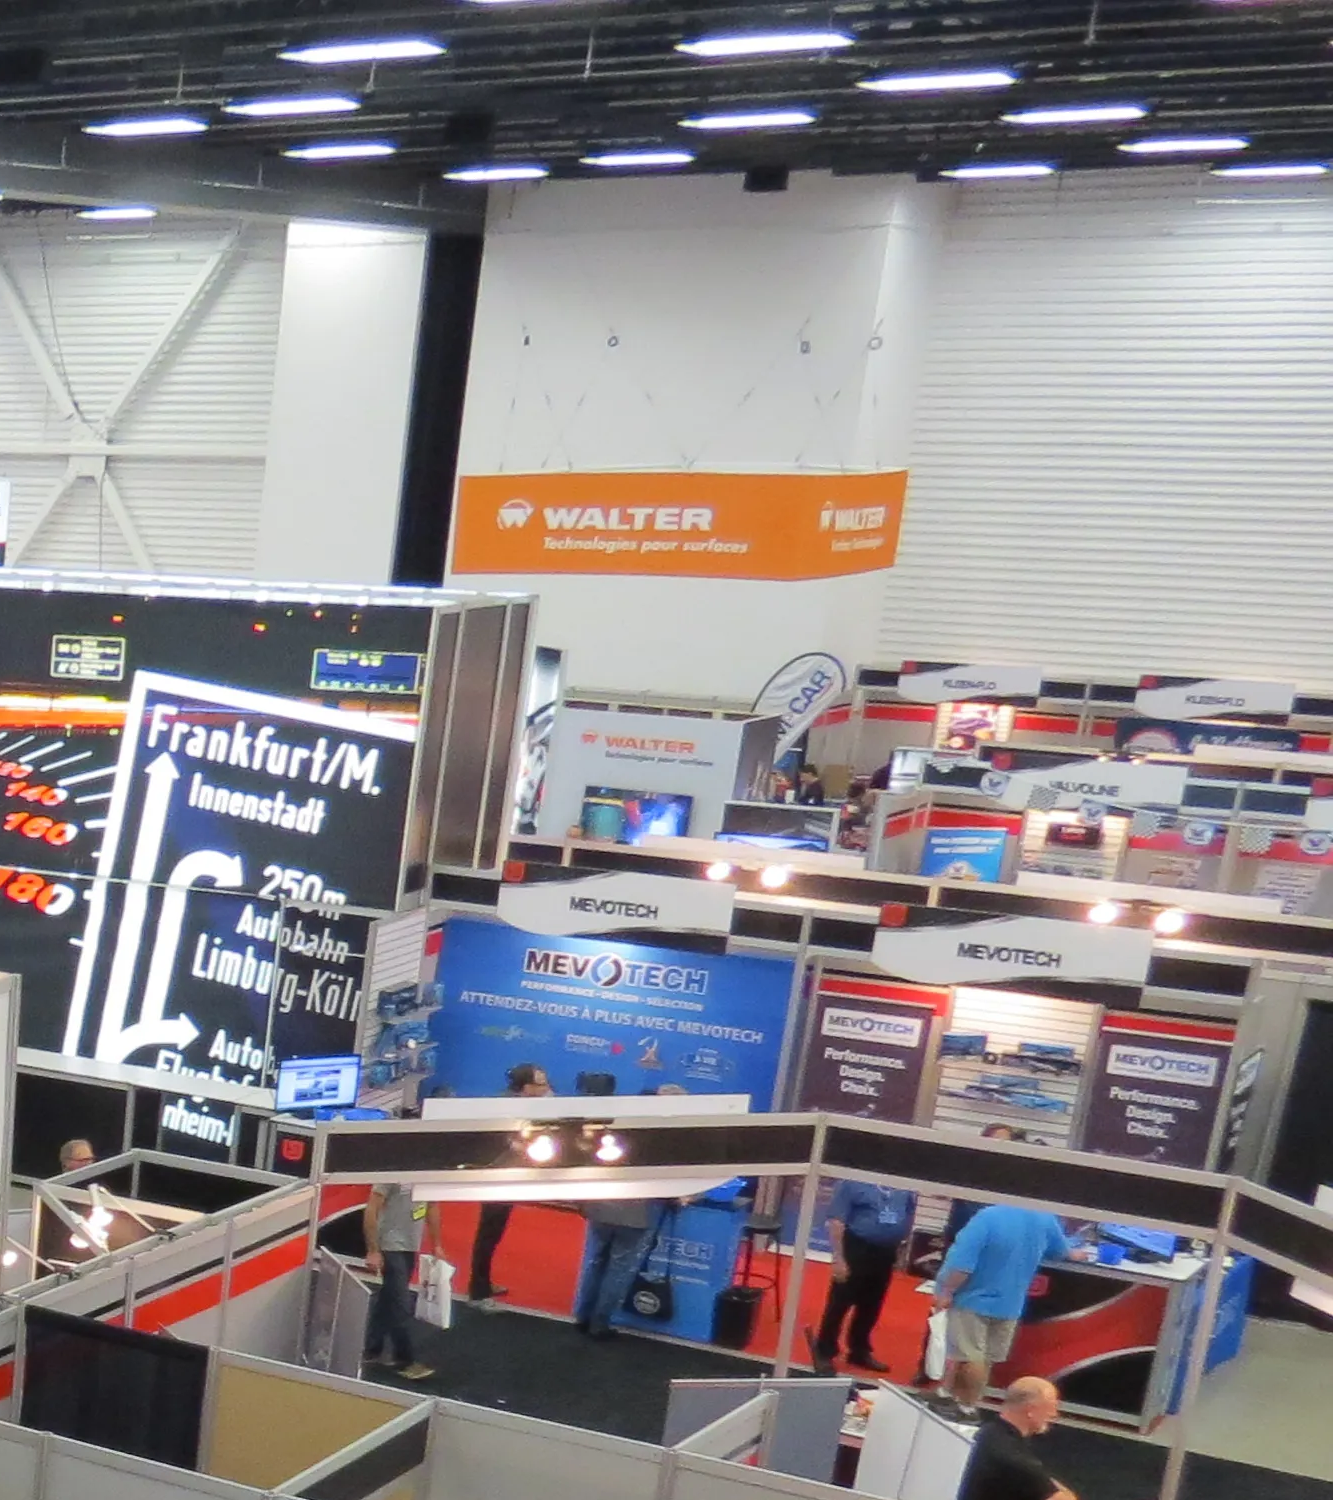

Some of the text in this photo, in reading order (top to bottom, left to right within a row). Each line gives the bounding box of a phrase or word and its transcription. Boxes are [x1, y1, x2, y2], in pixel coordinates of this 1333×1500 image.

[543, 506, 713, 532] WALTER
[834, 504, 886, 530] WALTER
[543, 535, 749, 555] Technologies pour surfaces
[146, 703, 382, 797] Frankfurt/M.
[604, 735, 696, 755] WALTER
[3, 781, 69, 806] 140
[187, 770, 328, 838] Innenstadt
[2, 811, 79, 845] 160
[568, 896, 660, 921] MEVOTECH
[235, 902, 350, 965] Autobahn
[955, 941, 1063, 970] MEVOTECH
[522, 947, 710, 997] MEVOTECH
[459, 990, 579, 1021] ATTENDEZ-VOUS
[594, 1007, 633, 1027] PLUS
[635, 1014, 675, 1033] AVEC
[676, 1020, 764, 1045] MEVOTECH
[827, 1013, 915, 1038] MEVOTECH
[1112, 1050, 1211, 1078] MEVOTECH
